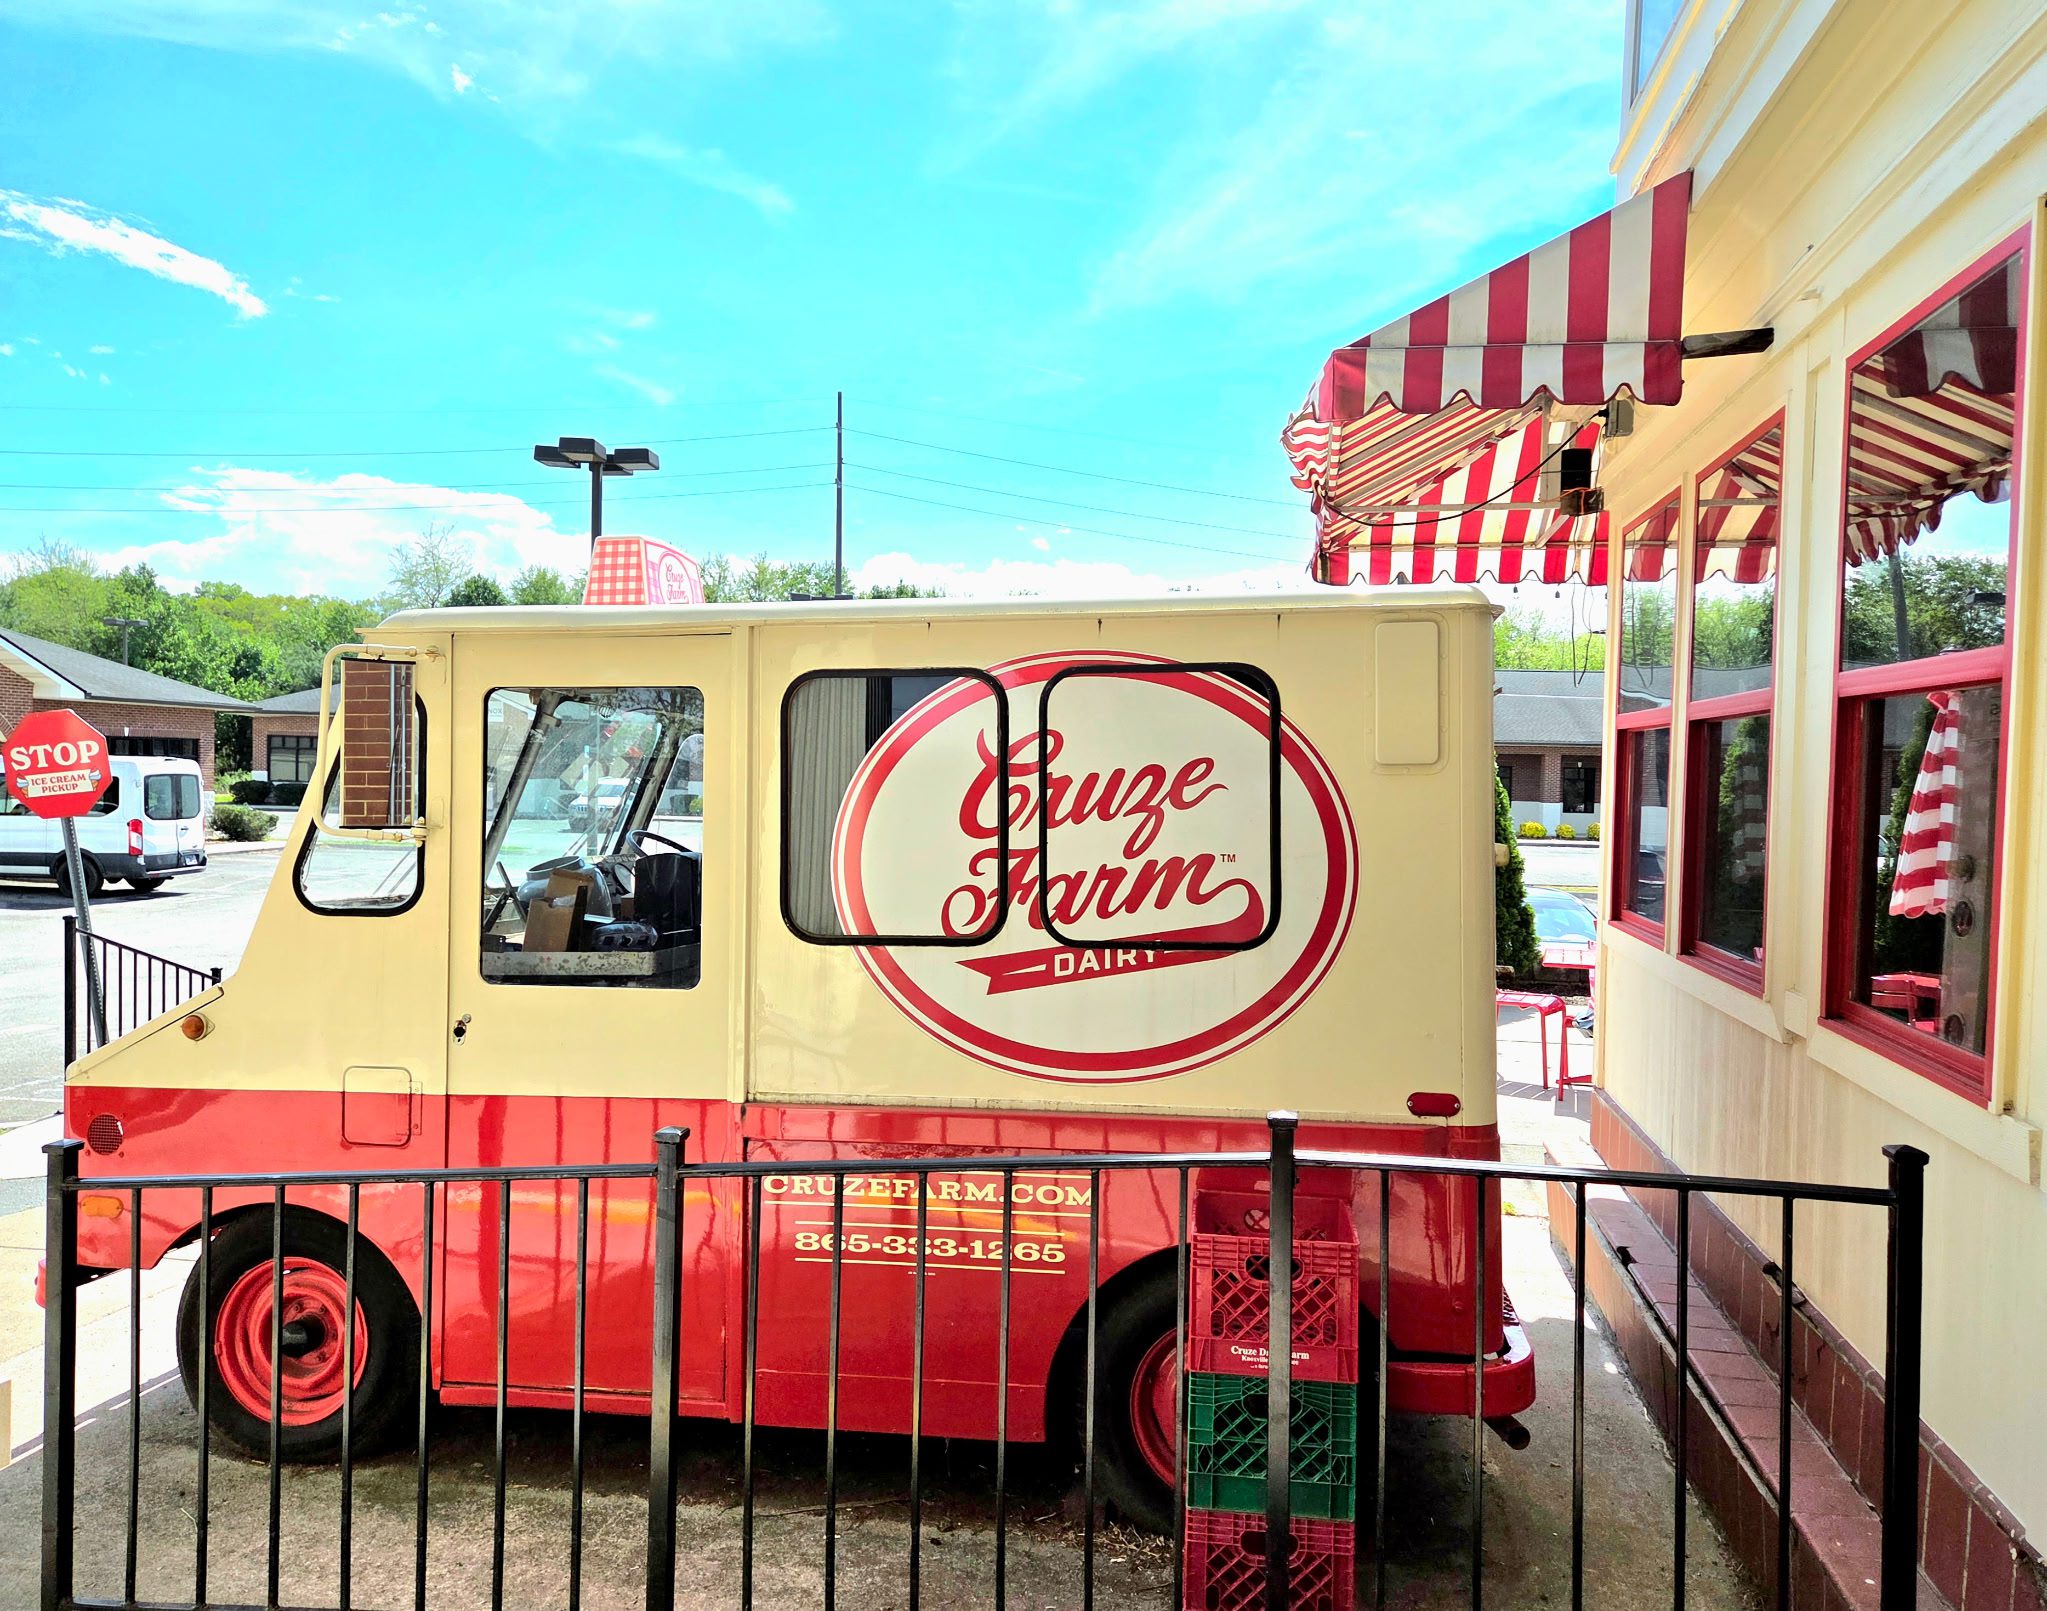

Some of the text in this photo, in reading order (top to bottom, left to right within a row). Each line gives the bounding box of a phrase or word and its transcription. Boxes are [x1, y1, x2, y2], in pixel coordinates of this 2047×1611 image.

[10, 740, 100, 771] STOP
[31, 773, 87, 787] ICE CREAM
[41, 783, 78, 794] PICKUP
[959, 728, 1229, 860] Cruze
[941, 847, 1265, 941] Farm
[1053, 948, 1156, 978] DAIRY
[763, 1175, 1092, 1206] CRUZEFARM.COM
[794, 1232, 1066, 1263] 865-333-1265
[1231, 1345, 1257, 1356] Cruze
[1291, 1350, 1310, 1360] arm
